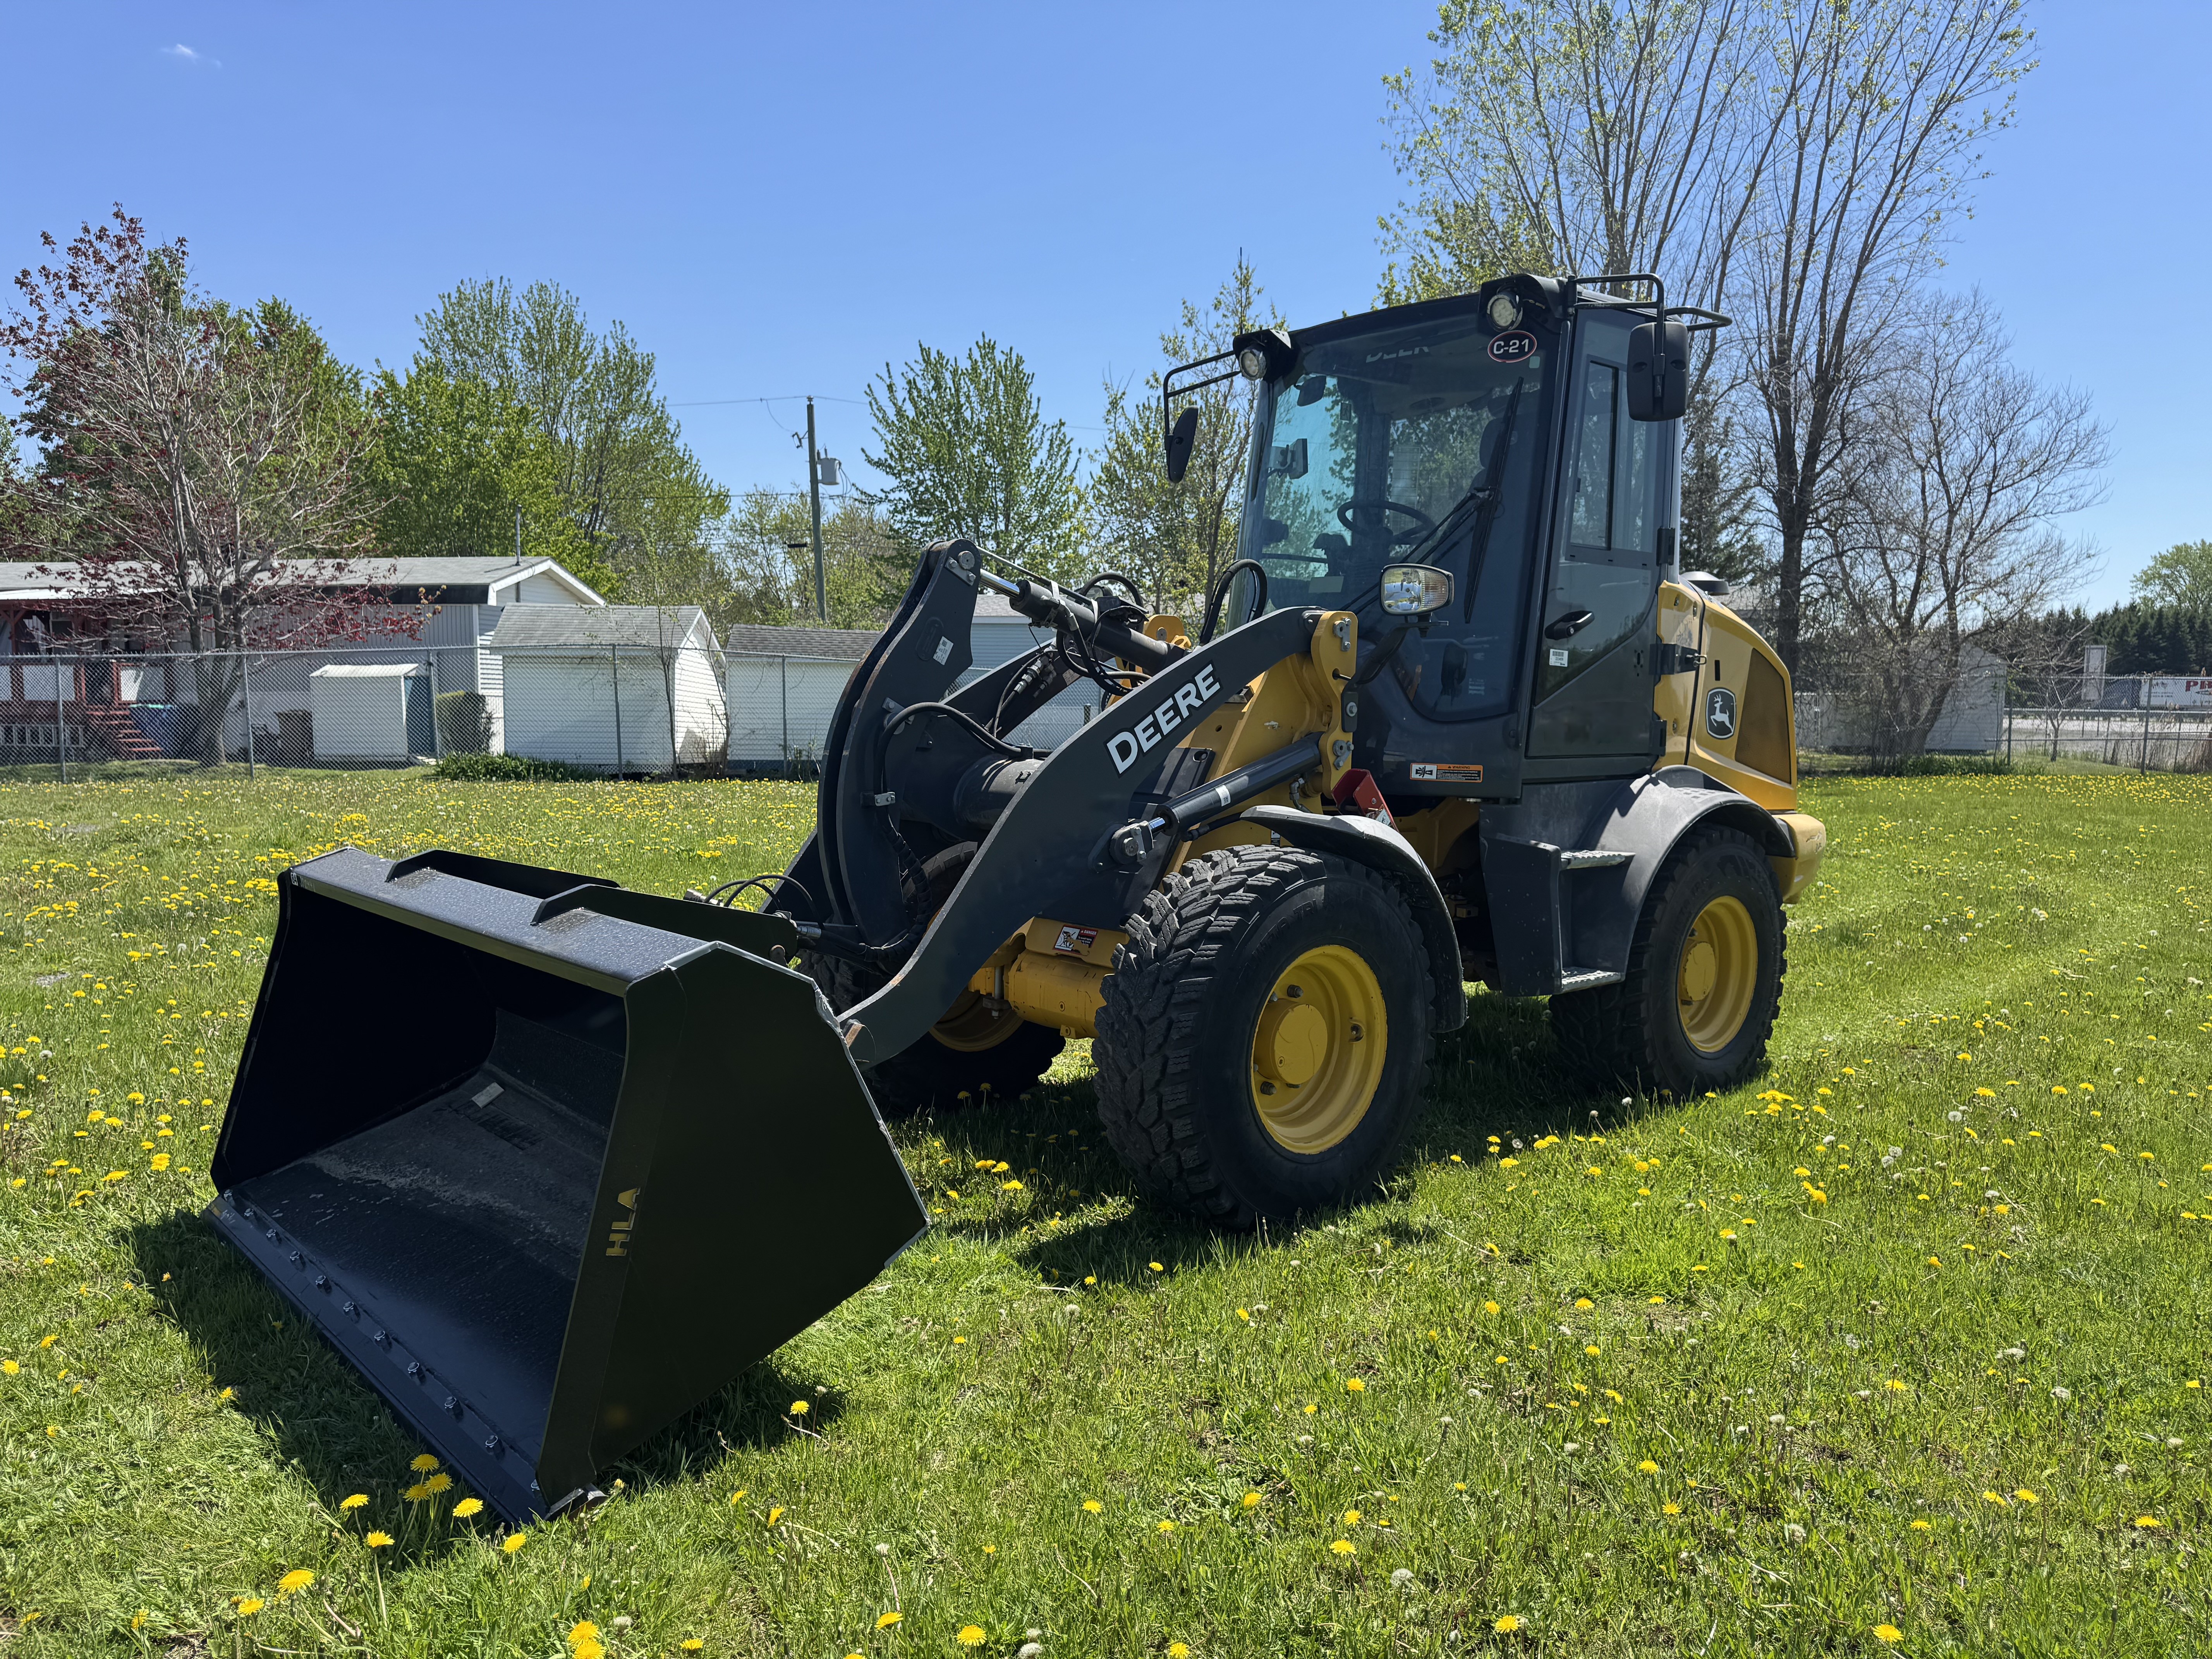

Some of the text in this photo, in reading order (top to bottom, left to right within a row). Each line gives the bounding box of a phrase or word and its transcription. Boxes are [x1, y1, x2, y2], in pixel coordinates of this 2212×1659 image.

[1493, 339, 1529, 354] C-21
[1106, 664, 1221, 774] DEERE
[606, 1187, 641, 1256] HLA
